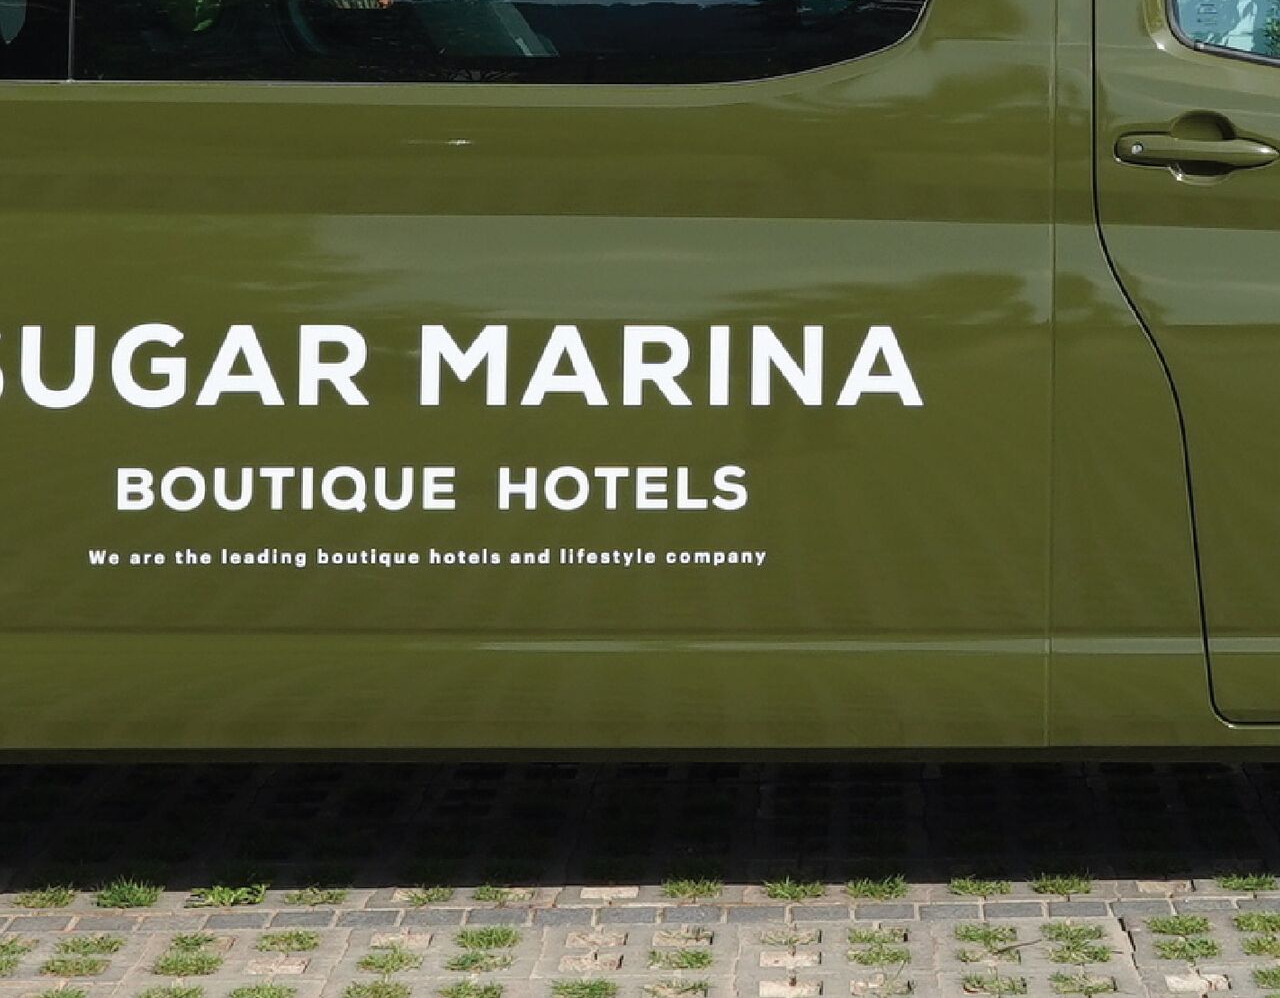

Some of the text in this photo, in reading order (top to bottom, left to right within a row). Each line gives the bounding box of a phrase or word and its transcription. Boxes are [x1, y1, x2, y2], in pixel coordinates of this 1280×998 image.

[419, 324, 924, 406] MARINA
[117, 465, 748, 513] BOUTIQUE HOTELS
[88, 547, 767, 569] We are the leading boutique hotels and lifestyle company
